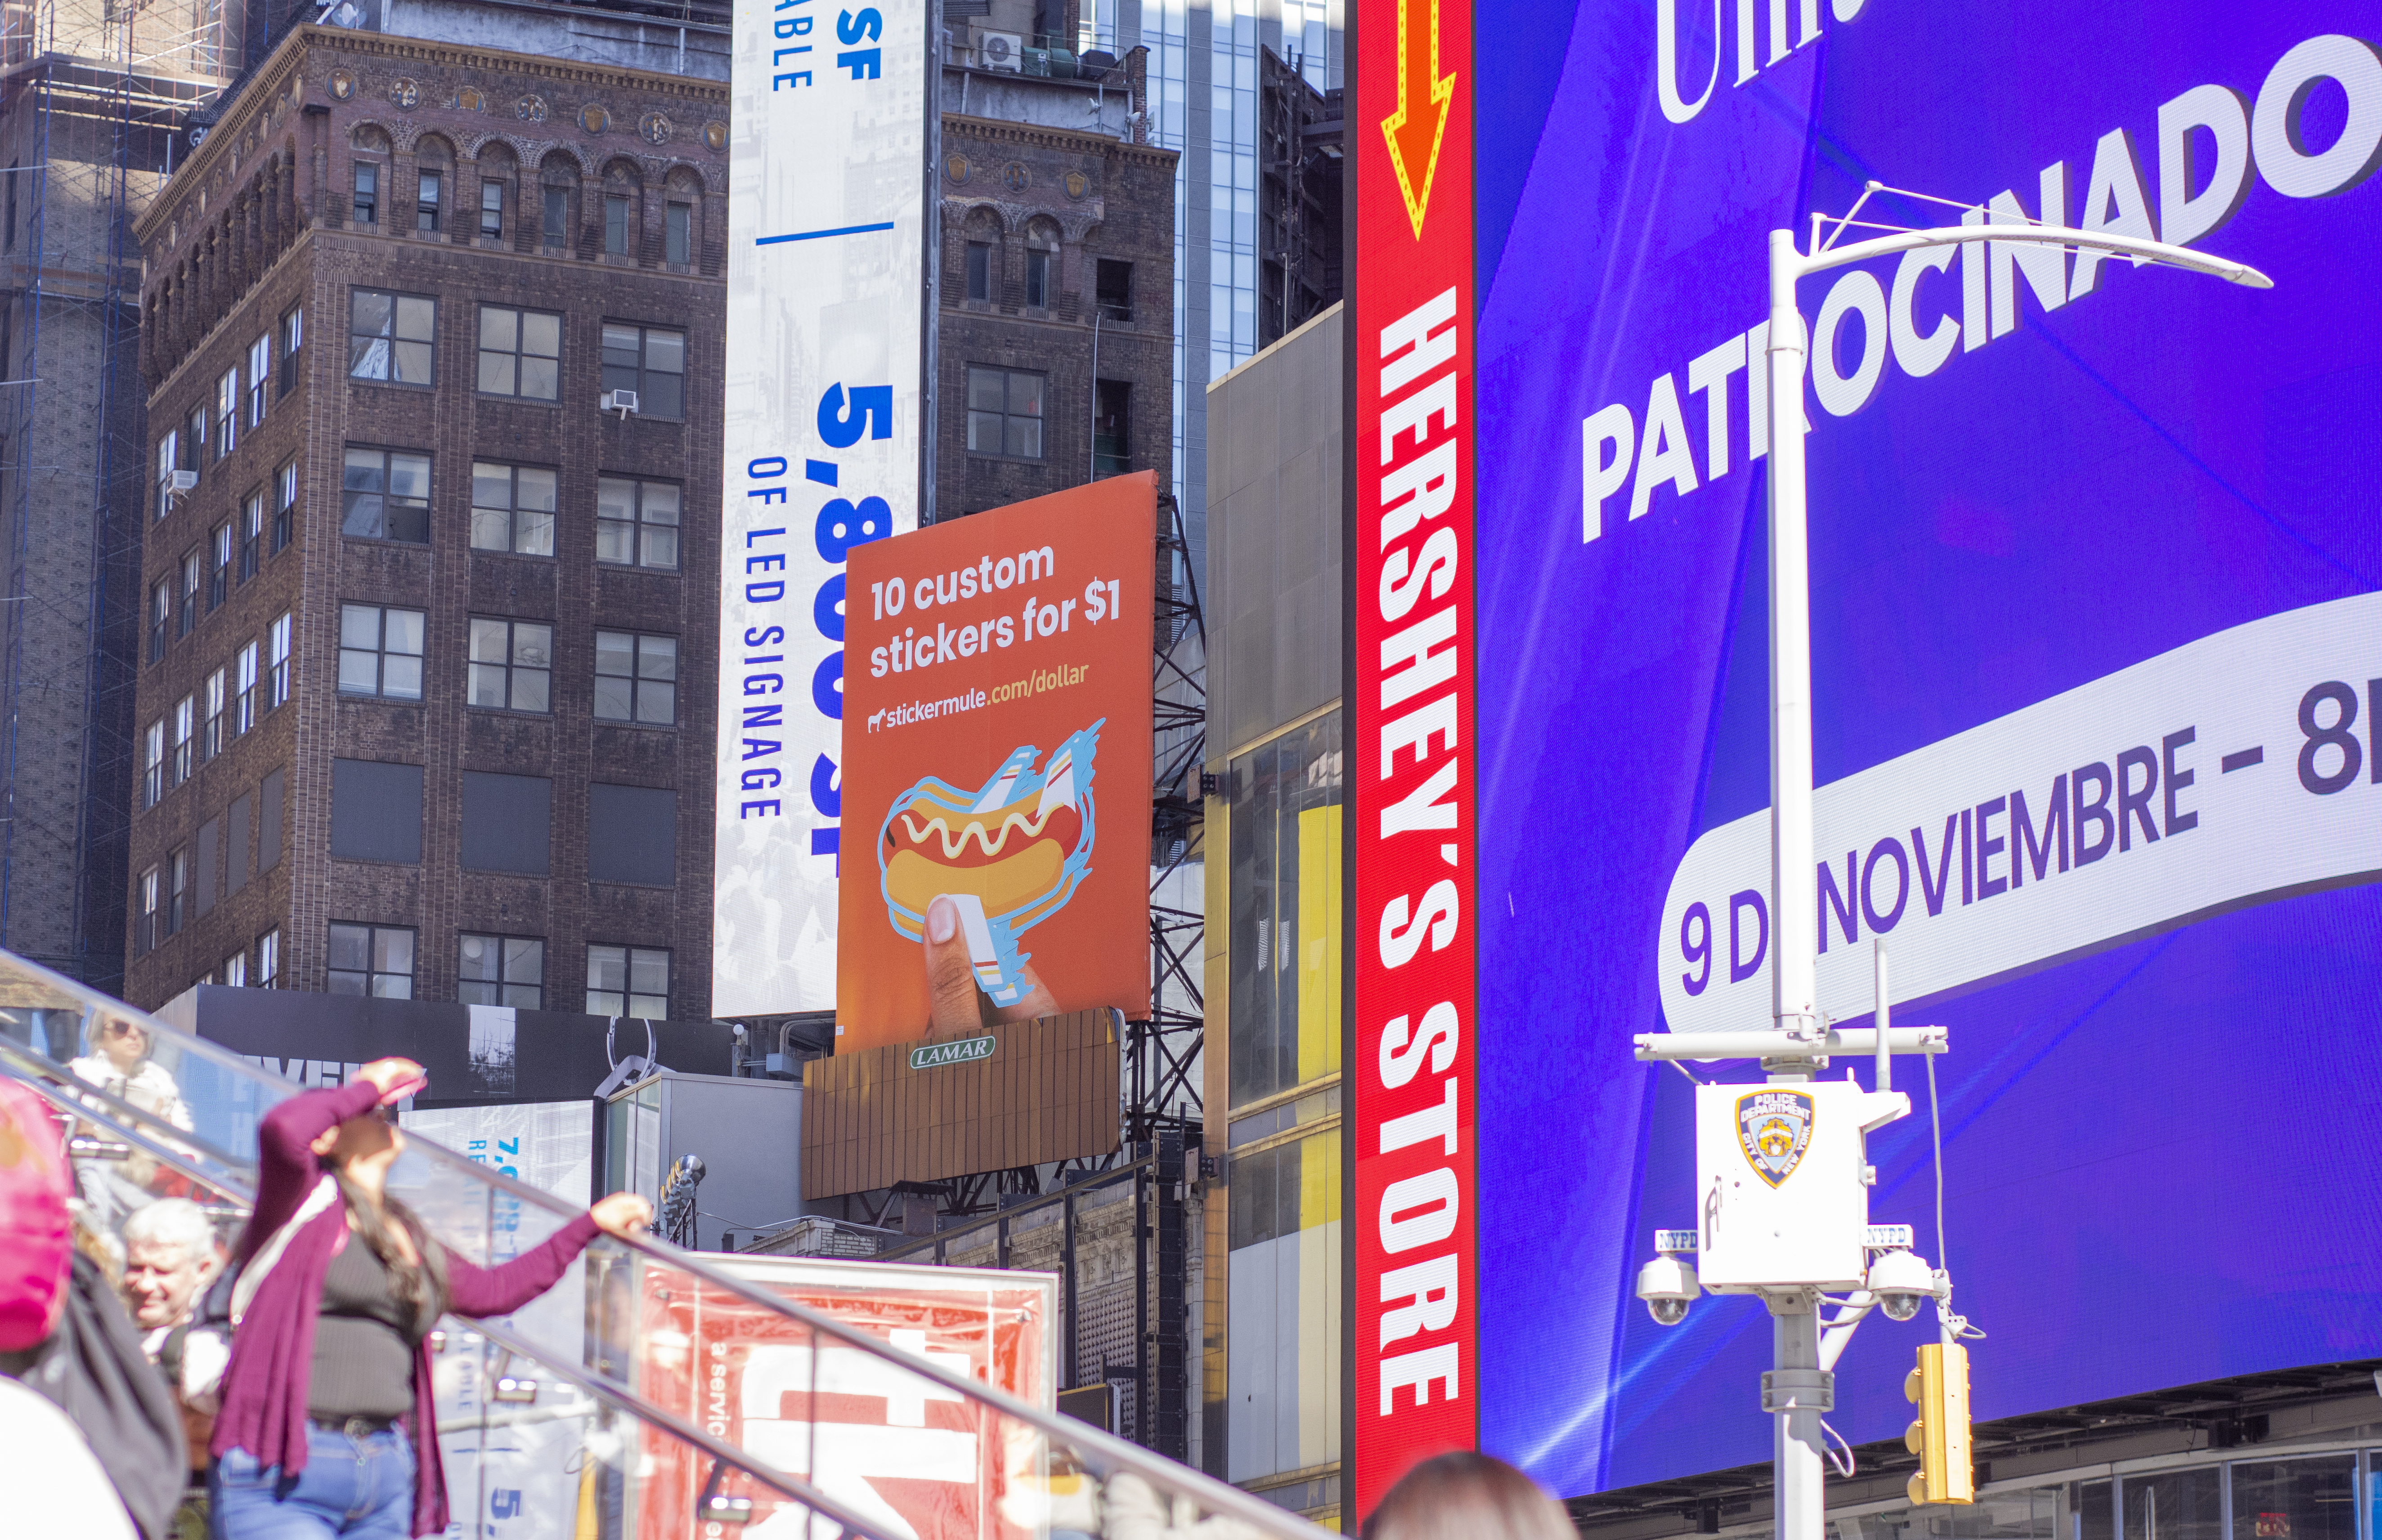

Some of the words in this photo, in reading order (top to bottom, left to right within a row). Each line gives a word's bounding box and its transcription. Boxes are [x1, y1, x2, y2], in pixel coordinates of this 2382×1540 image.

[837, 7, 883, 80] SF
[747, 456, 788, 509] OF
[745, 527, 786, 604] LED
[871, 577, 905, 621] 10
[914, 546, 1054, 609] custom
[870, 615, 1014, 678] stickers
[1023, 596, 1076, 641] for
[1084, 576, 1120, 625] $1
[1379, 285, 1458, 969] HERSHEY'S
[740, 625, 785, 820] SIGNAGE
[886, 663, 1089, 728] stickermule.com/dollar
[1681, 901, 1711, 996] 9
[1817, 725, 2198, 954] NOVIEMBRE
[917, 1040, 987, 1065] LAMAR
[1740, 1103, 1811, 1122] DEPARTMENT
[1754, 1093, 1797, 1106] POLICE
[1742, 1133, 1758, 1155] CITY
[1781, 1153, 1799, 1175] NEW
[1796, 1125, 1811, 1151] YORK
[1379, 1001, 1458, 1416] STORE
[1660, 1232, 1697, 1249] NYPD
[1867, 1227, 1906, 1243] NYPD
[711, 1342, 727, 1357] a
[707, 1364, 731, 1442] servic
